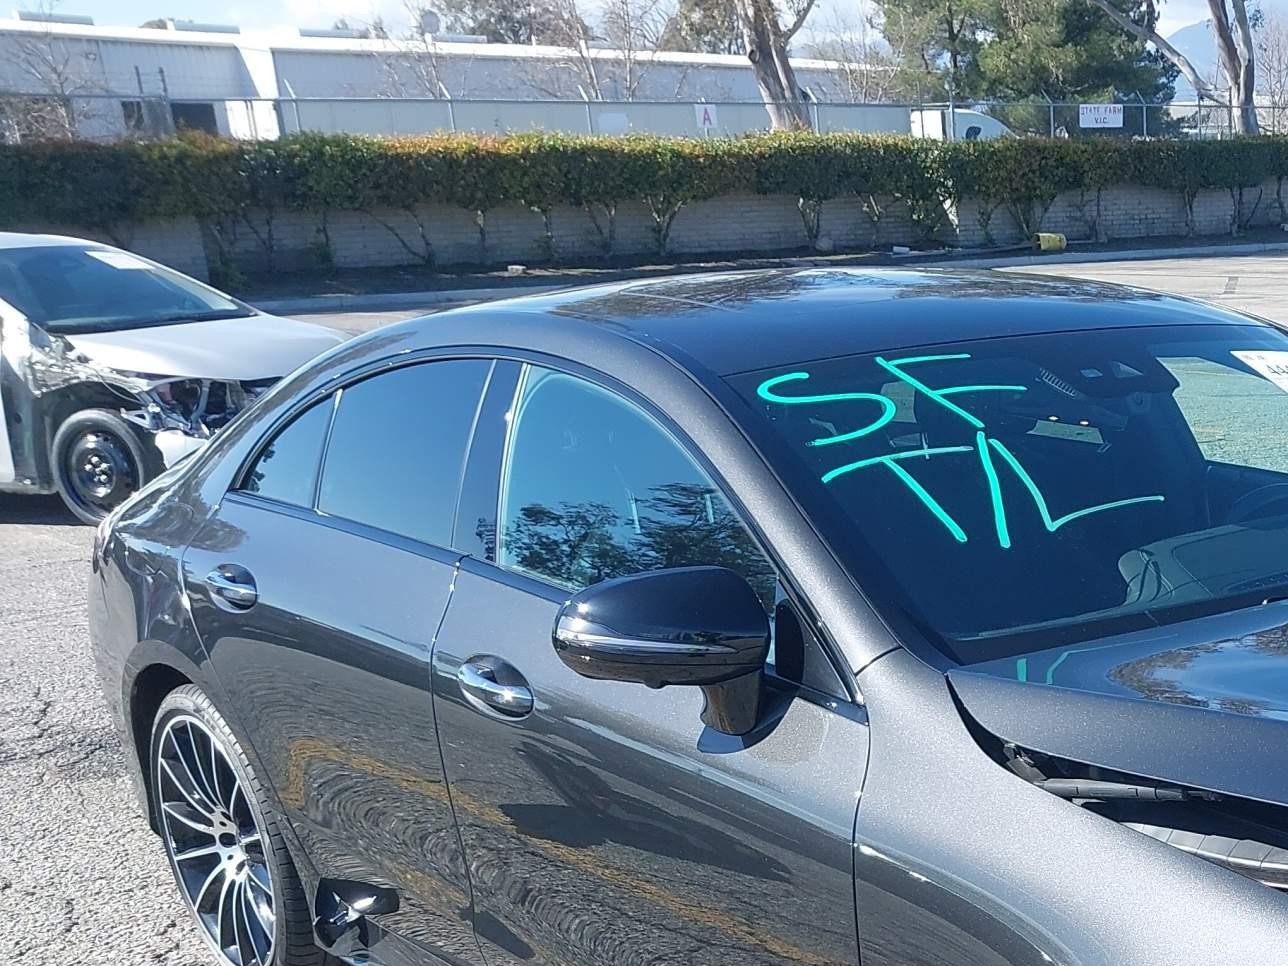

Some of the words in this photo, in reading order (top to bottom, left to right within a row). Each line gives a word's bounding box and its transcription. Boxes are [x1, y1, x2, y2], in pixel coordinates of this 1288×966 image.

[703, 107, 712, 125] A
[1080, 106, 1100, 115] STATE
[1104, 106, 1122, 115] FARM
